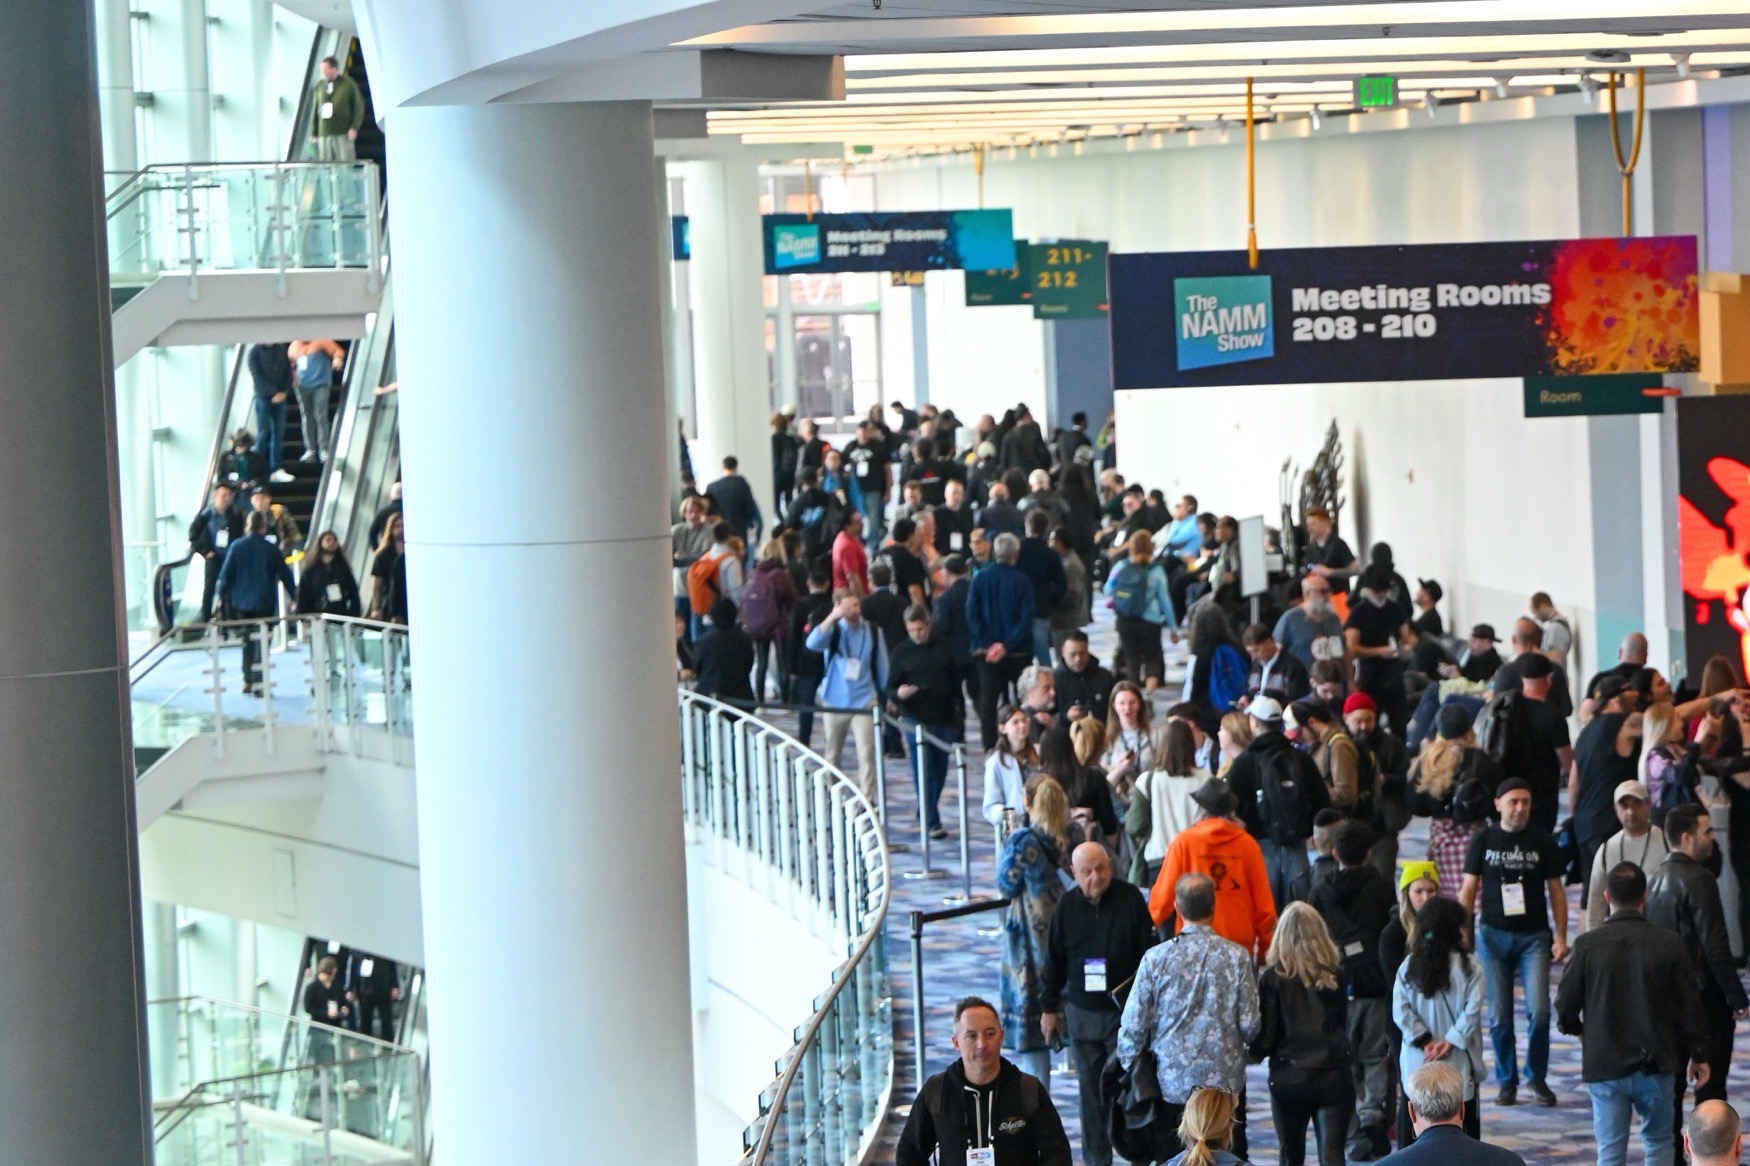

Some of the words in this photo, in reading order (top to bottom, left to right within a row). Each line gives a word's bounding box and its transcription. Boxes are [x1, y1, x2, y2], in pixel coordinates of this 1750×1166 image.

[1047, 248, 1093, 265] 211-
[1038, 270, 1077, 288] 212
[1186, 294, 1218, 313] The
[1292, 284, 1431, 313] Meeting
[1437, 282, 1551, 307] Rooms
[1182, 303, 1266, 339] NAMM
[1293, 315, 1357, 341] 208
[1381, 313, 1437, 339] 210
[1218, 332, 1264, 351] Show
[1540, 390, 1582, 404] Room
